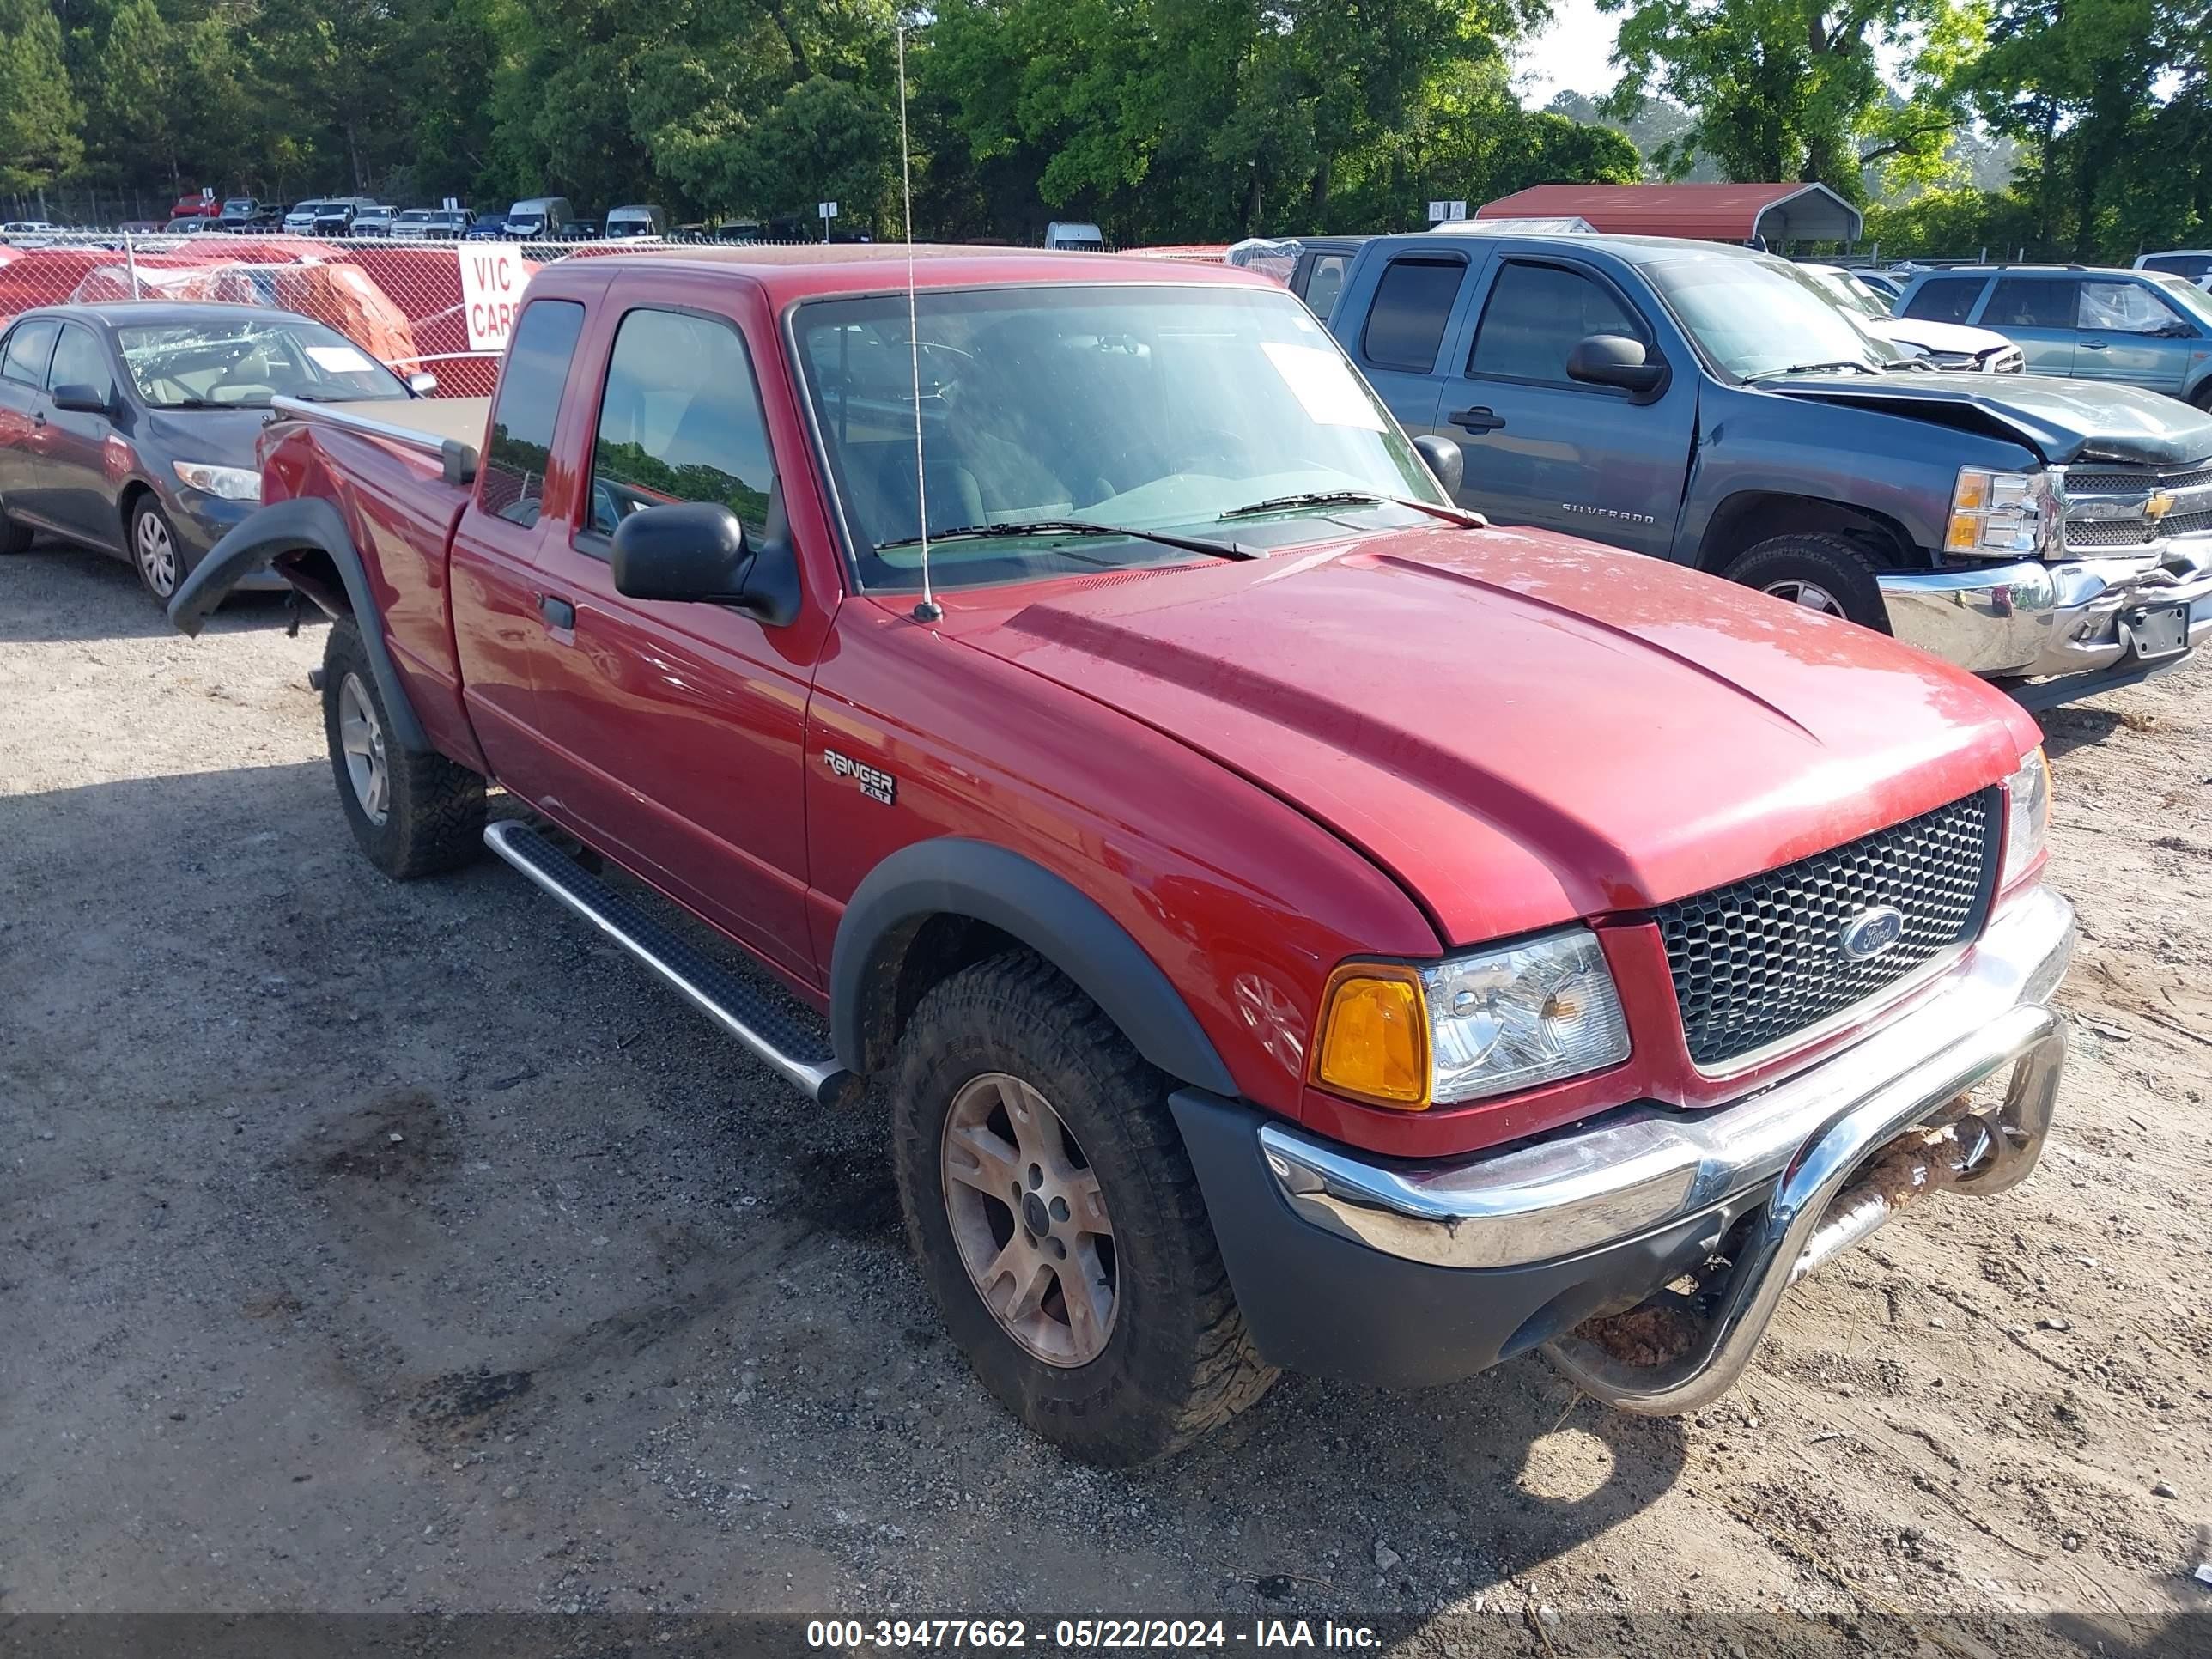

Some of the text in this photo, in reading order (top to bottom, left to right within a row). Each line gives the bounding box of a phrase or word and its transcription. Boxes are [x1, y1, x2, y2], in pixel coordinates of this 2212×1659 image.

[1432, 204, 1441, 218] B
[1451, 203, 1464, 218] A
[473, 257, 511, 291] VIC
[1562, 503, 1655, 524] SILVERADO
[823, 748, 894, 793] RANGER
[863, 784, 890, 802] XLT
[1863, 920, 1893, 949] Ford
